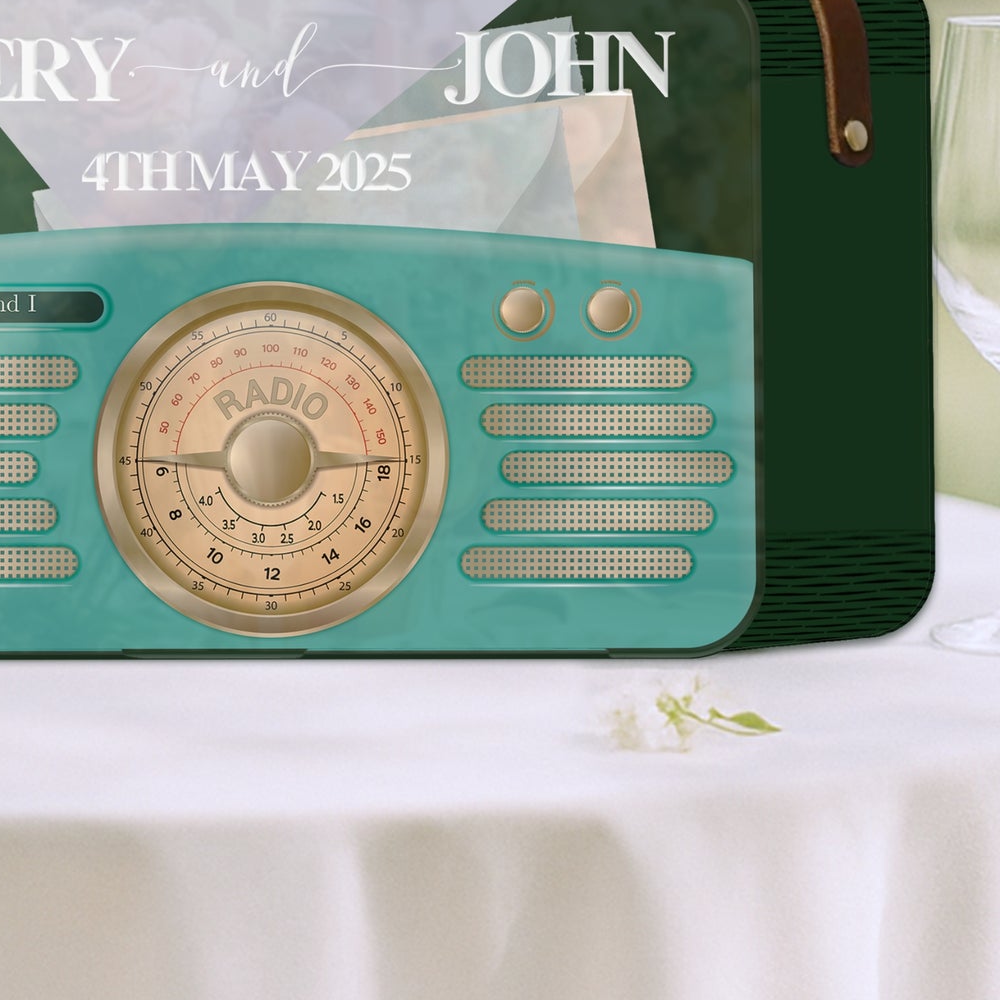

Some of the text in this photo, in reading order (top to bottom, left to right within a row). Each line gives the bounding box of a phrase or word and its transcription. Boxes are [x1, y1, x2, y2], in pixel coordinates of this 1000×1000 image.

[444, 31, 677, 105] JOHN
[81, 150, 412, 192] 4TH MAY 2025
[28, 294, 37, 312] I
[264, 313, 276, 322] 60
[191, 332, 204, 341] 55
[342, 331, 348, 340] 5
[234, 348, 247, 358] 90
[262, 344, 279, 352] 100
[293, 346, 308, 357] 110
[210, 357, 223, 369] 80
[320, 357, 337, 371] 120
[188, 372, 201, 384] 70
[345, 374, 360, 391] 130
[139, 382, 152, 391] 50
[390, 383, 402, 391] 10
[171, 394, 183, 406] 60
[213, 377, 328, 420] RADIO
[363, 398, 376, 415] 140
[159, 421, 169, 434] 50
[376, 428, 386, 445] 150
[119, 456, 131, 465] 45
[410, 455, 421, 463] 15
[156, 467, 169, 476] 6
[377, 465, 390, 481] 18
[199, 496, 213, 506] 4.0
[333, 494, 344, 503] 1.5
[169, 509, 182, 520] 8
[223, 520, 235, 529] 3.5
[308, 521, 321, 530] 2.0
[355, 517, 371, 533] 16
[141, 528, 153, 537] 40
[392, 529, 404, 537] 20
[252, 533, 265, 543] 3.0
[280, 534, 293, 543] 2.5
[206, 547, 223, 564] 10
[322, 548, 340, 564] 14
[264, 567, 280, 580] 12
[192, 581, 204, 590] 35
[339, 582, 351, 590] 25
[265, 601, 277, 610] 30
